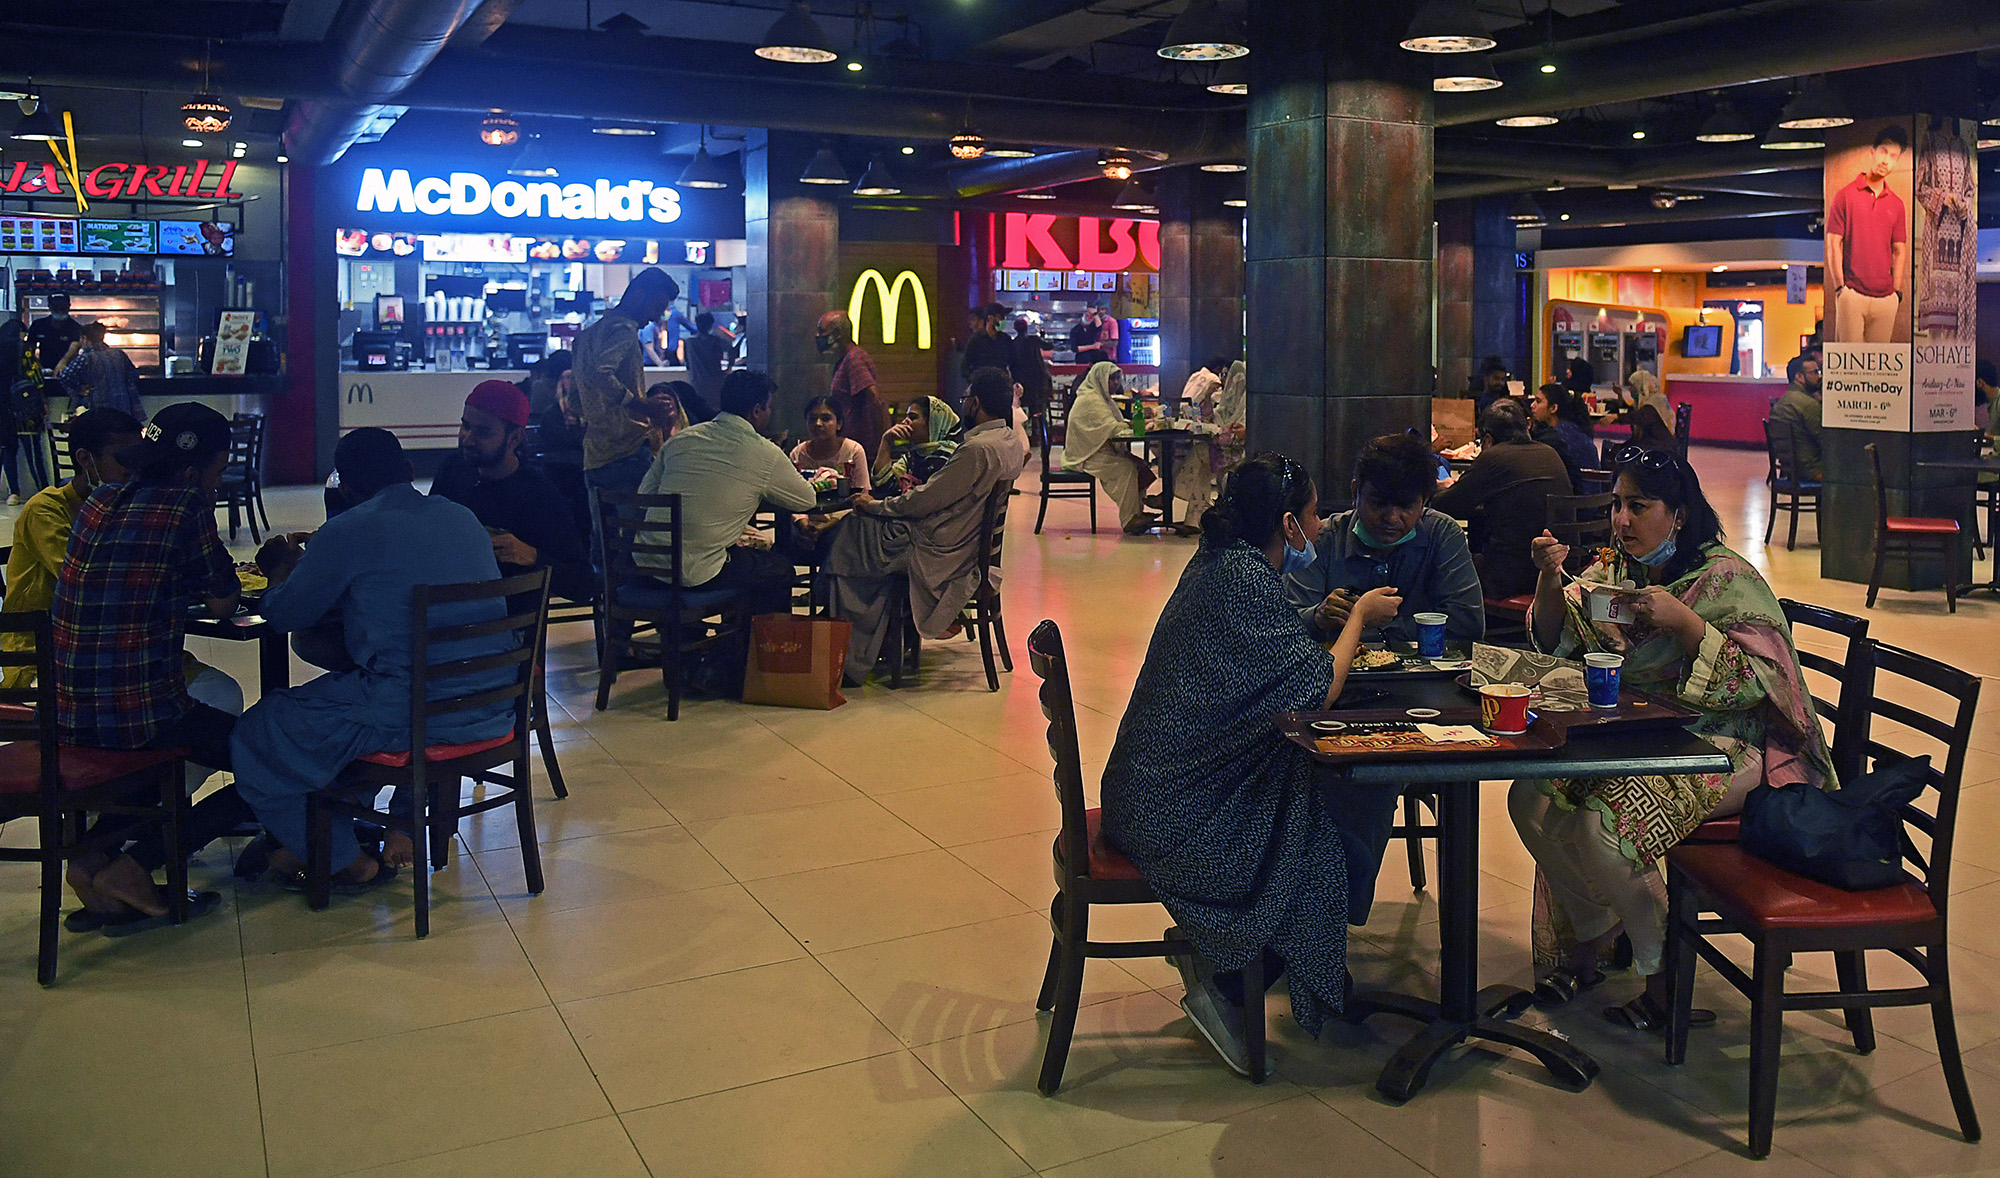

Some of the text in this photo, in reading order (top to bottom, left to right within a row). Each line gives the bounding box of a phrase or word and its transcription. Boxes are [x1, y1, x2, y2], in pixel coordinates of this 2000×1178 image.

[84, 158, 243, 200] GRILL
[356, 167, 682, 223] McDonald's
[1827, 352, 1904, 371] DINERS
[1826, 380, 1903, 396] #OwnTheDay
[1837, 399, 1872, 410] MARCH
